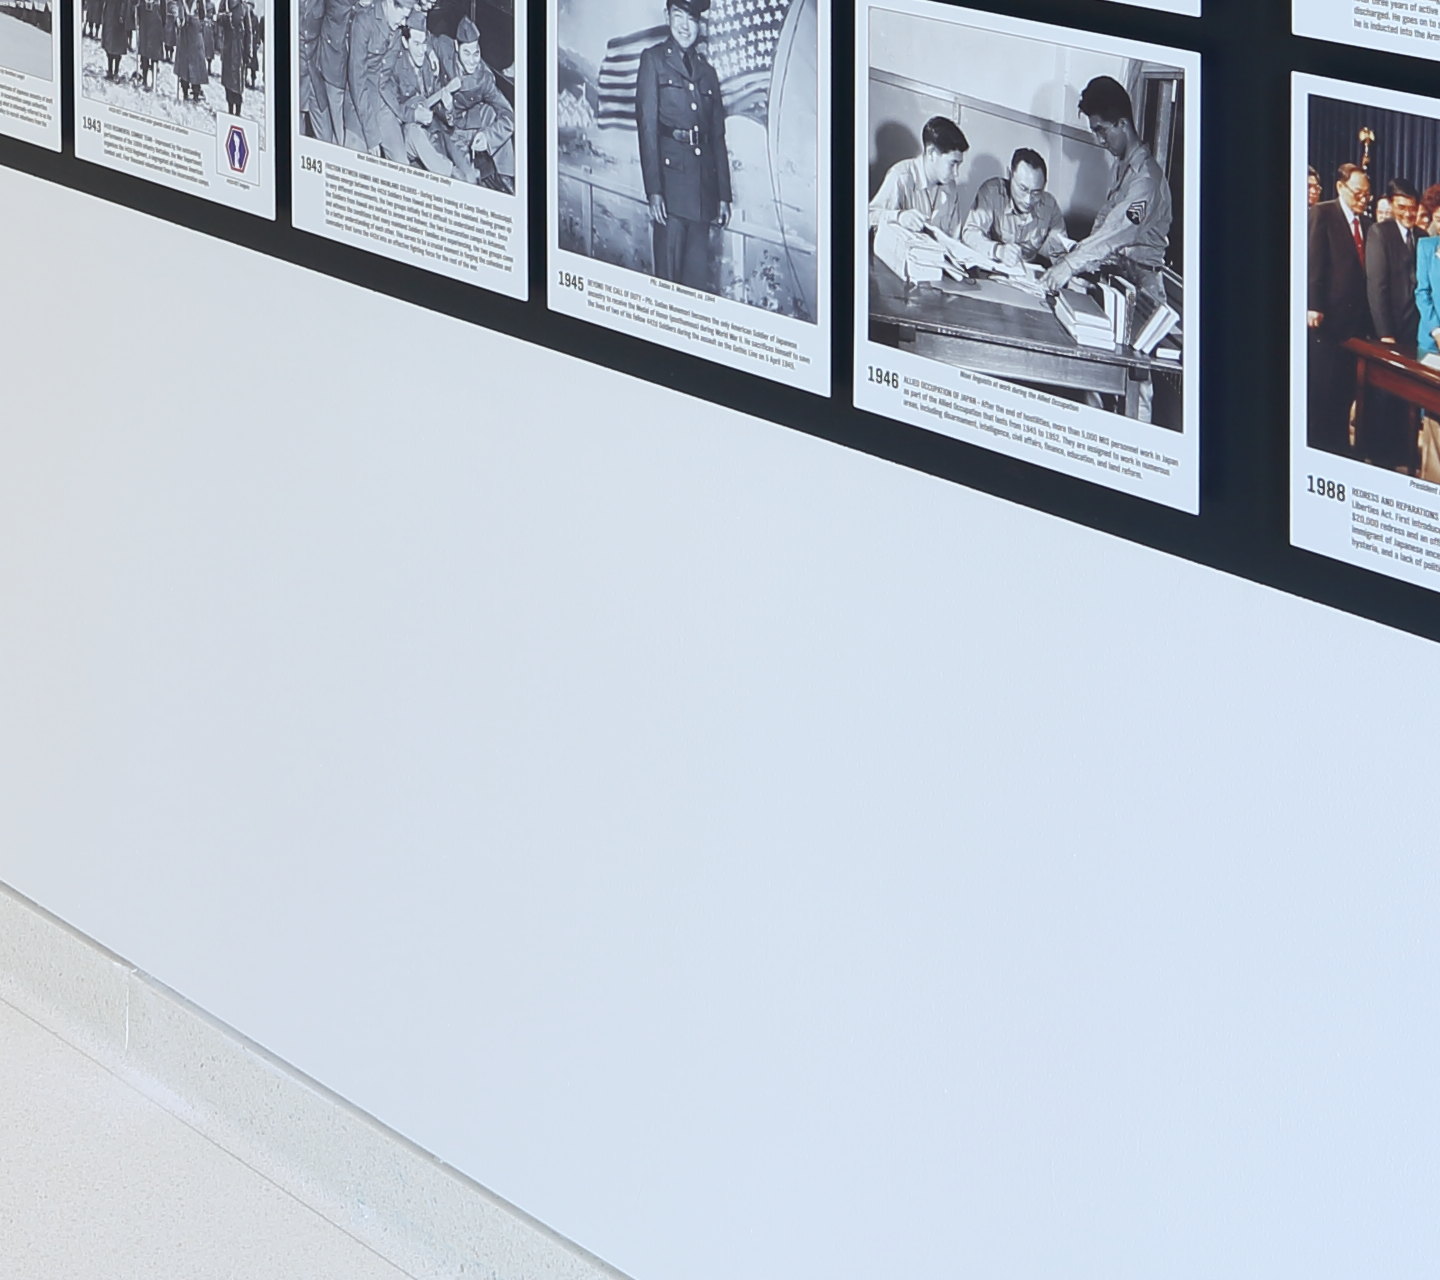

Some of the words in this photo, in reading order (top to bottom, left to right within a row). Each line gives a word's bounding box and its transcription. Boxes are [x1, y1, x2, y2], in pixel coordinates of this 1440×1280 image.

[83, 117, 101, 133] 1943
[302, 156, 322, 173] 1943
[559, 271, 583, 291] 1945
[868, 366, 898, 388] 1946
[1308, 475, 1345, 502] 1988
